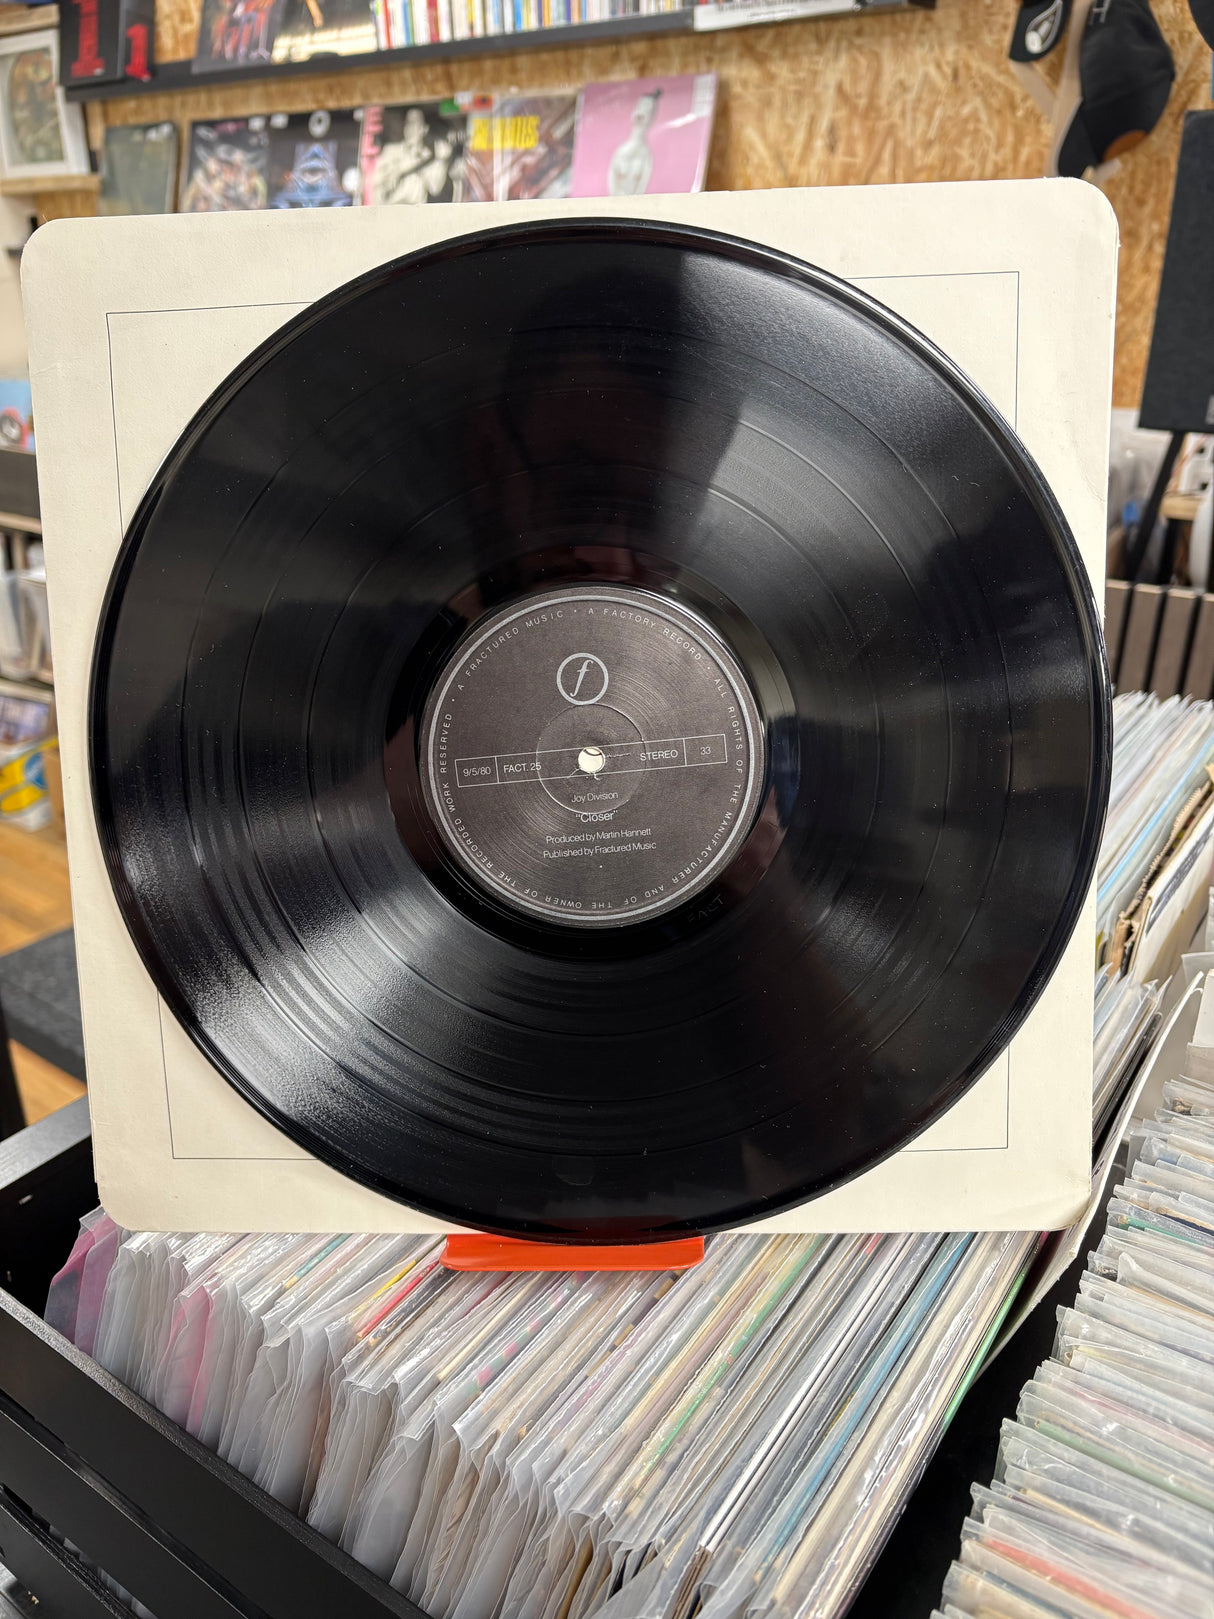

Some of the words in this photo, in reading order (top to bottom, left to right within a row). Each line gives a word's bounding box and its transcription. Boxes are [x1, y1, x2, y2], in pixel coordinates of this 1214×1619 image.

[588, 607, 594, 615] A
[603, 608, 656, 629] FACTORY
[662, 627, 702, 661] RECORD
[465, 627, 519, 677] FRACTURED
[525, 610, 564, 628] MUSIC
[714, 678, 728, 699] ALL
[727, 706, 743, 750] RIGHTS
[439, 713, 452, 773] RESERVED
[700, 746, 712, 756] 33
[640, 749, 679, 761] STEREO
[463, 766, 492, 777] 9/5/80
[503, 764, 529, 774] FACT.
[530, 762, 542, 771] 25
[735, 760, 744, 774] OF
[442, 782, 456, 813] WORK
[571, 793, 586, 804] Joy
[587, 791, 619, 802] Division
[729, 784, 742, 804] THE
[454, 818, 494, 869] RECORDED
[546, 833, 585, 845] Produced
[585, 833, 596, 844] by
[596, 830, 621, 841] Martin
[621, 828, 652, 838] Hannett
[543, 848, 583, 859] Published
[583, 847, 595, 857] by
[595, 844, 632, 855] Fractured
[632, 841, 657, 851] Music
[671, 811, 733, 884] MANUFACTURER
[498, 871, 516, 887] THE
[523, 888, 538, 898] OF
[644, 884, 665, 898] AND
[545, 895, 582, 909] OWNER
[624, 896, 637, 905] OF
